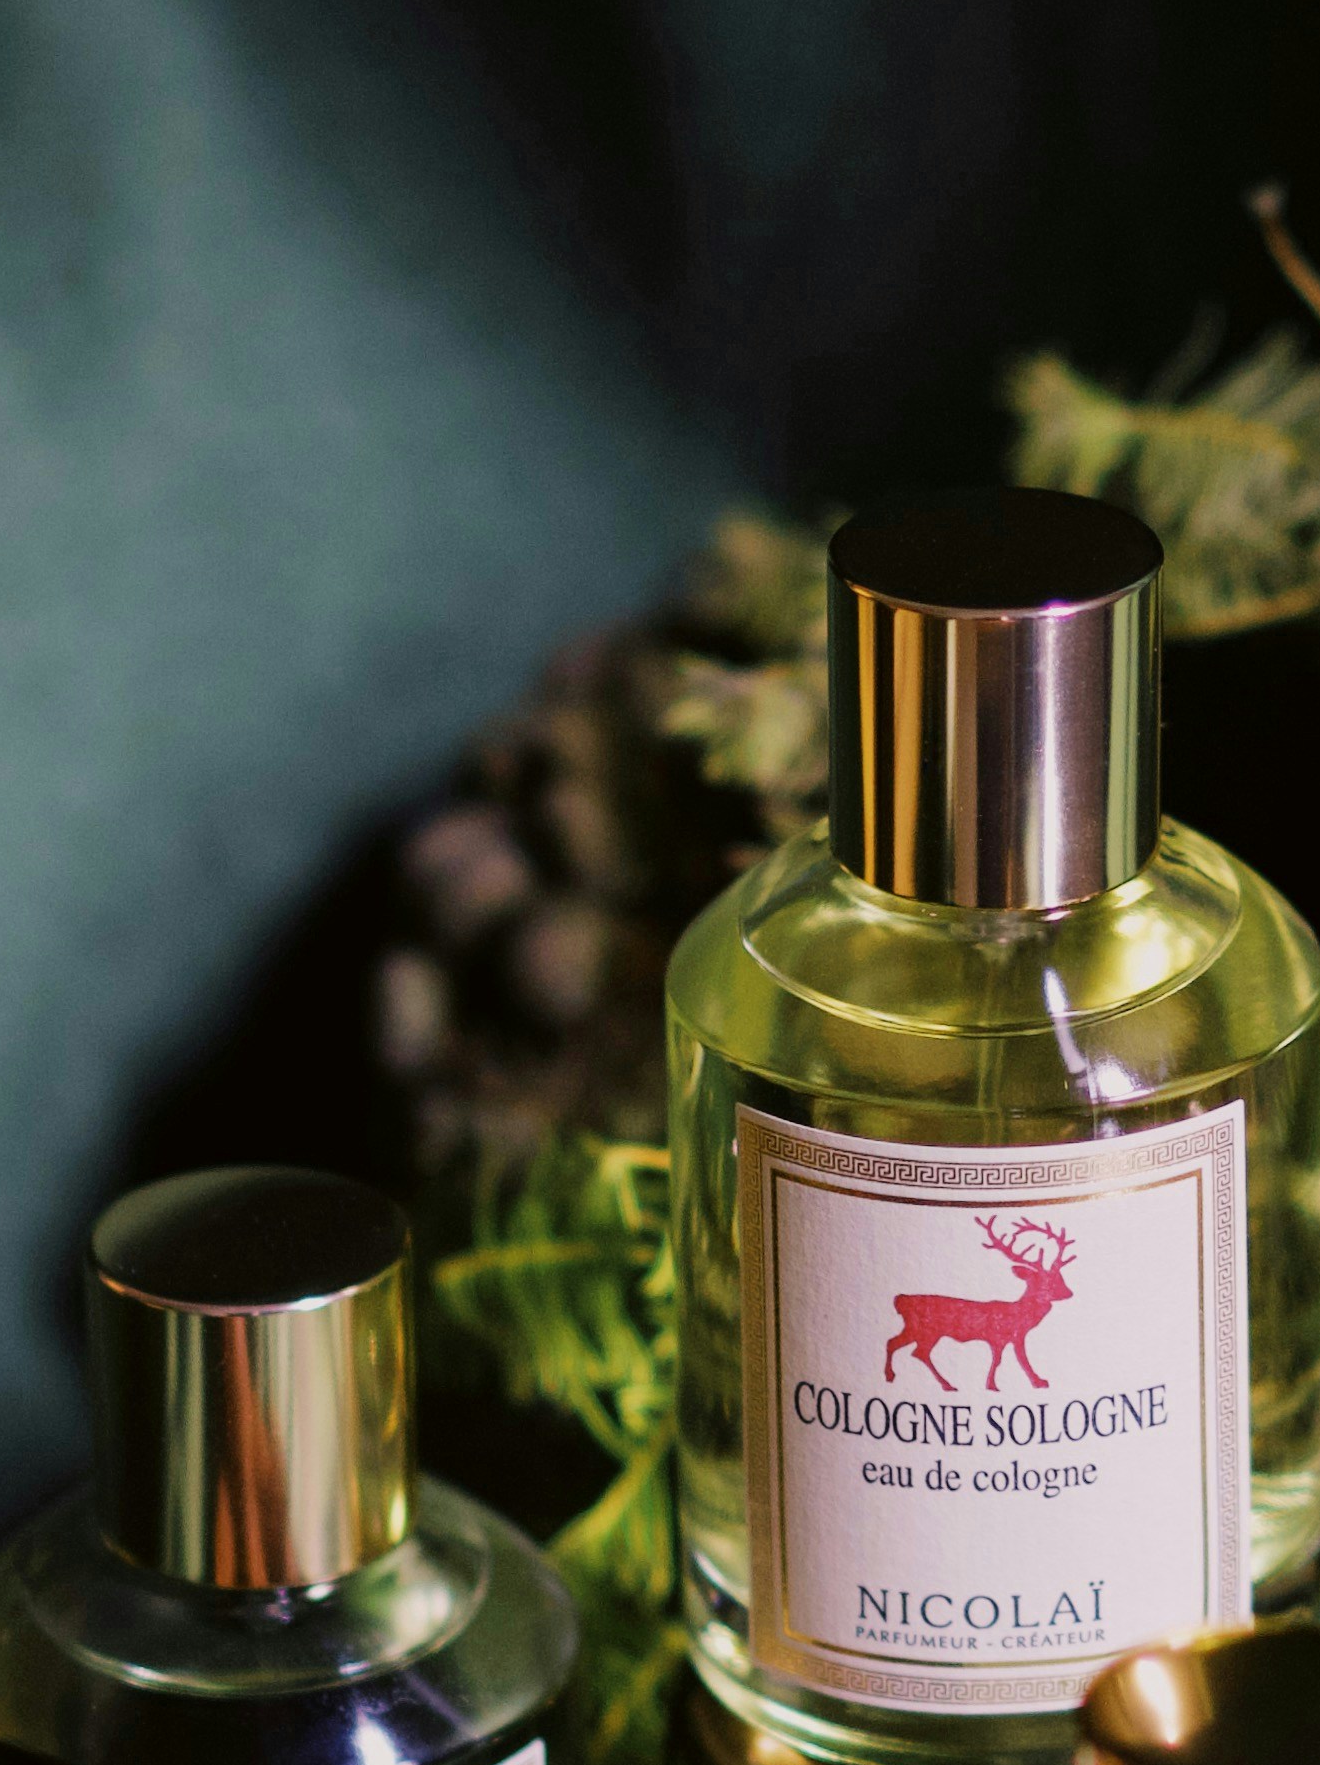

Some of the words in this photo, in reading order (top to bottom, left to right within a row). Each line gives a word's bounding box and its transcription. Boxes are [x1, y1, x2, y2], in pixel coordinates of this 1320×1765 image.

[794, 1381, 974, 1446] COLOGNE
[985, 1384, 1168, 1447] SOLOGNE
[862, 1461, 913, 1487] eau
[925, 1460, 961, 1492] de
[973, 1460, 1098, 1498] cologne
[857, 1580, 1104, 1629] NICOLAÏ
[856, 1626, 978, 1650] PARFUMEUR
[1002, 1628, 1106, 1649] CRÉATEUR
